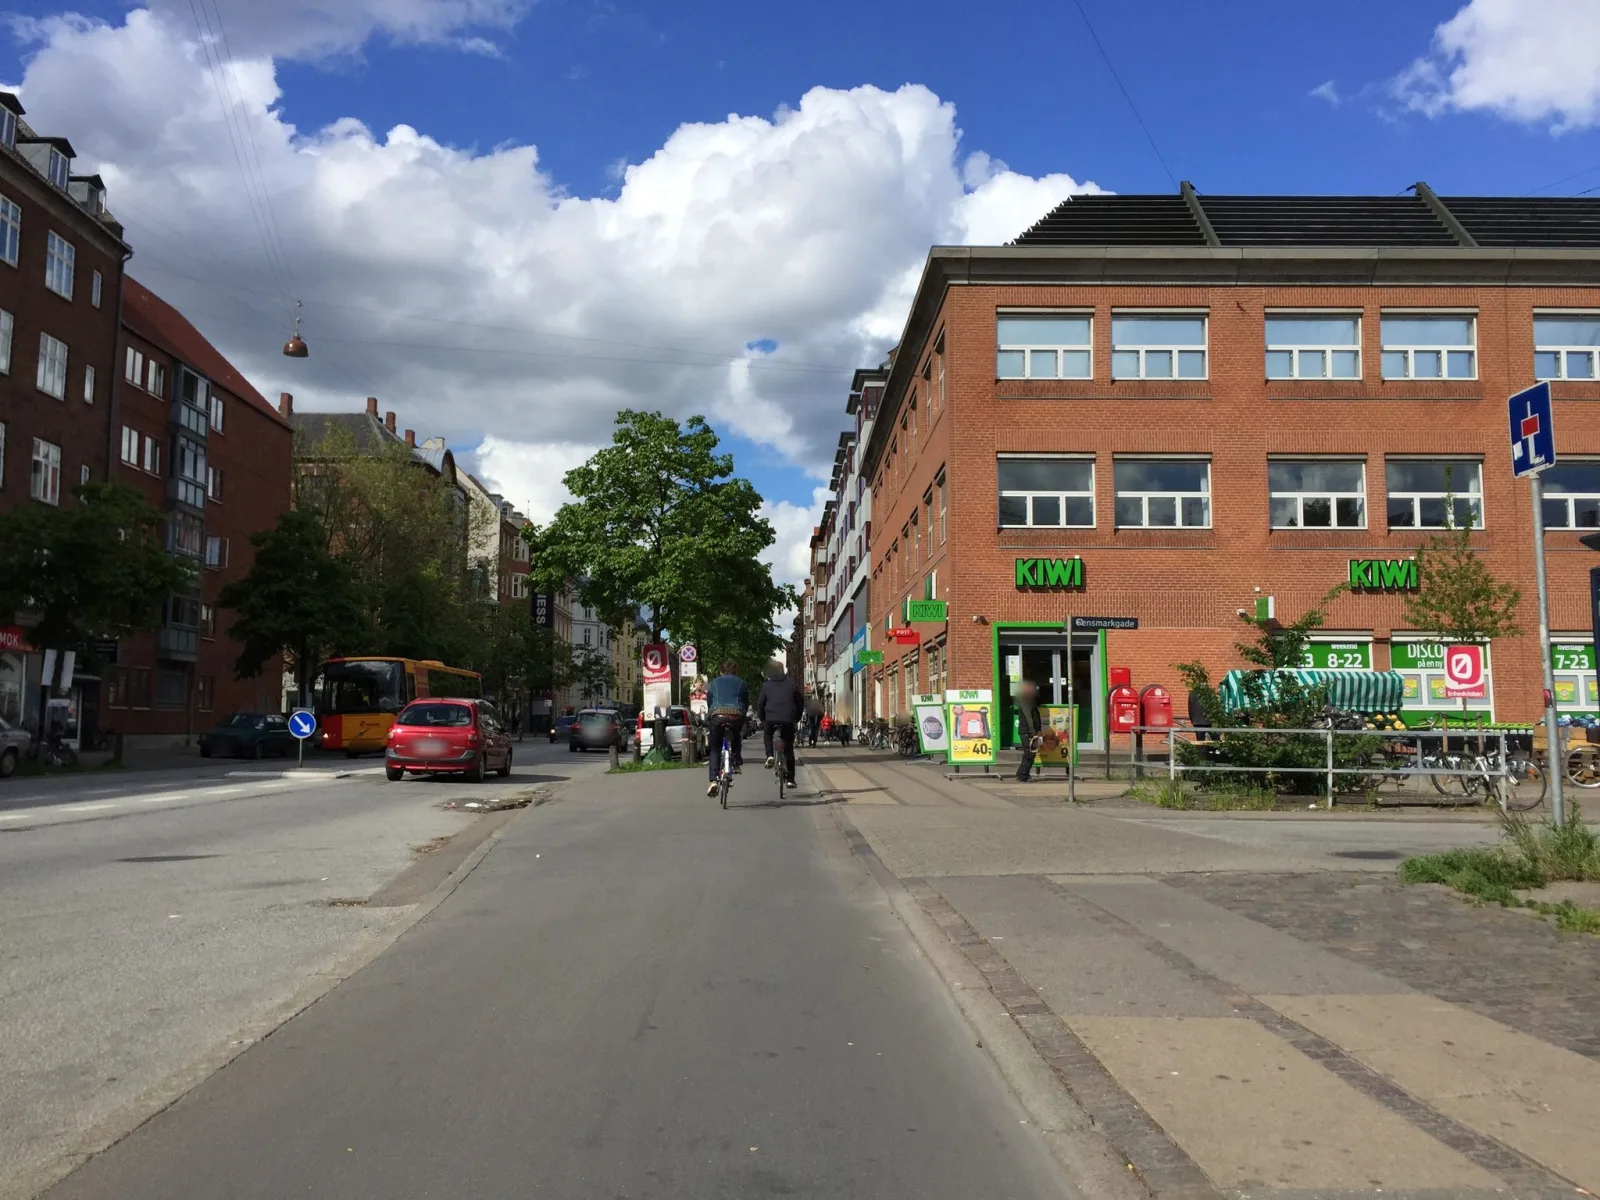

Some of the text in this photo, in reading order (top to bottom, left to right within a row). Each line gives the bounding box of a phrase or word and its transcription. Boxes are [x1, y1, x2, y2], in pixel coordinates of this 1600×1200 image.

[1015, 558, 1083, 587] KIWI
[1350, 559, 1418, 588] KIWI
[913, 604, 942, 618] KIWI
[1327, 653, 1363, 668] 8-22
[1417, 659, 1443, 669] på en ny
[1451, 653, 1472, 679] Ø
[1555, 654, 1590, 669] 7-23
[959, 690, 979, 699] KIWI
